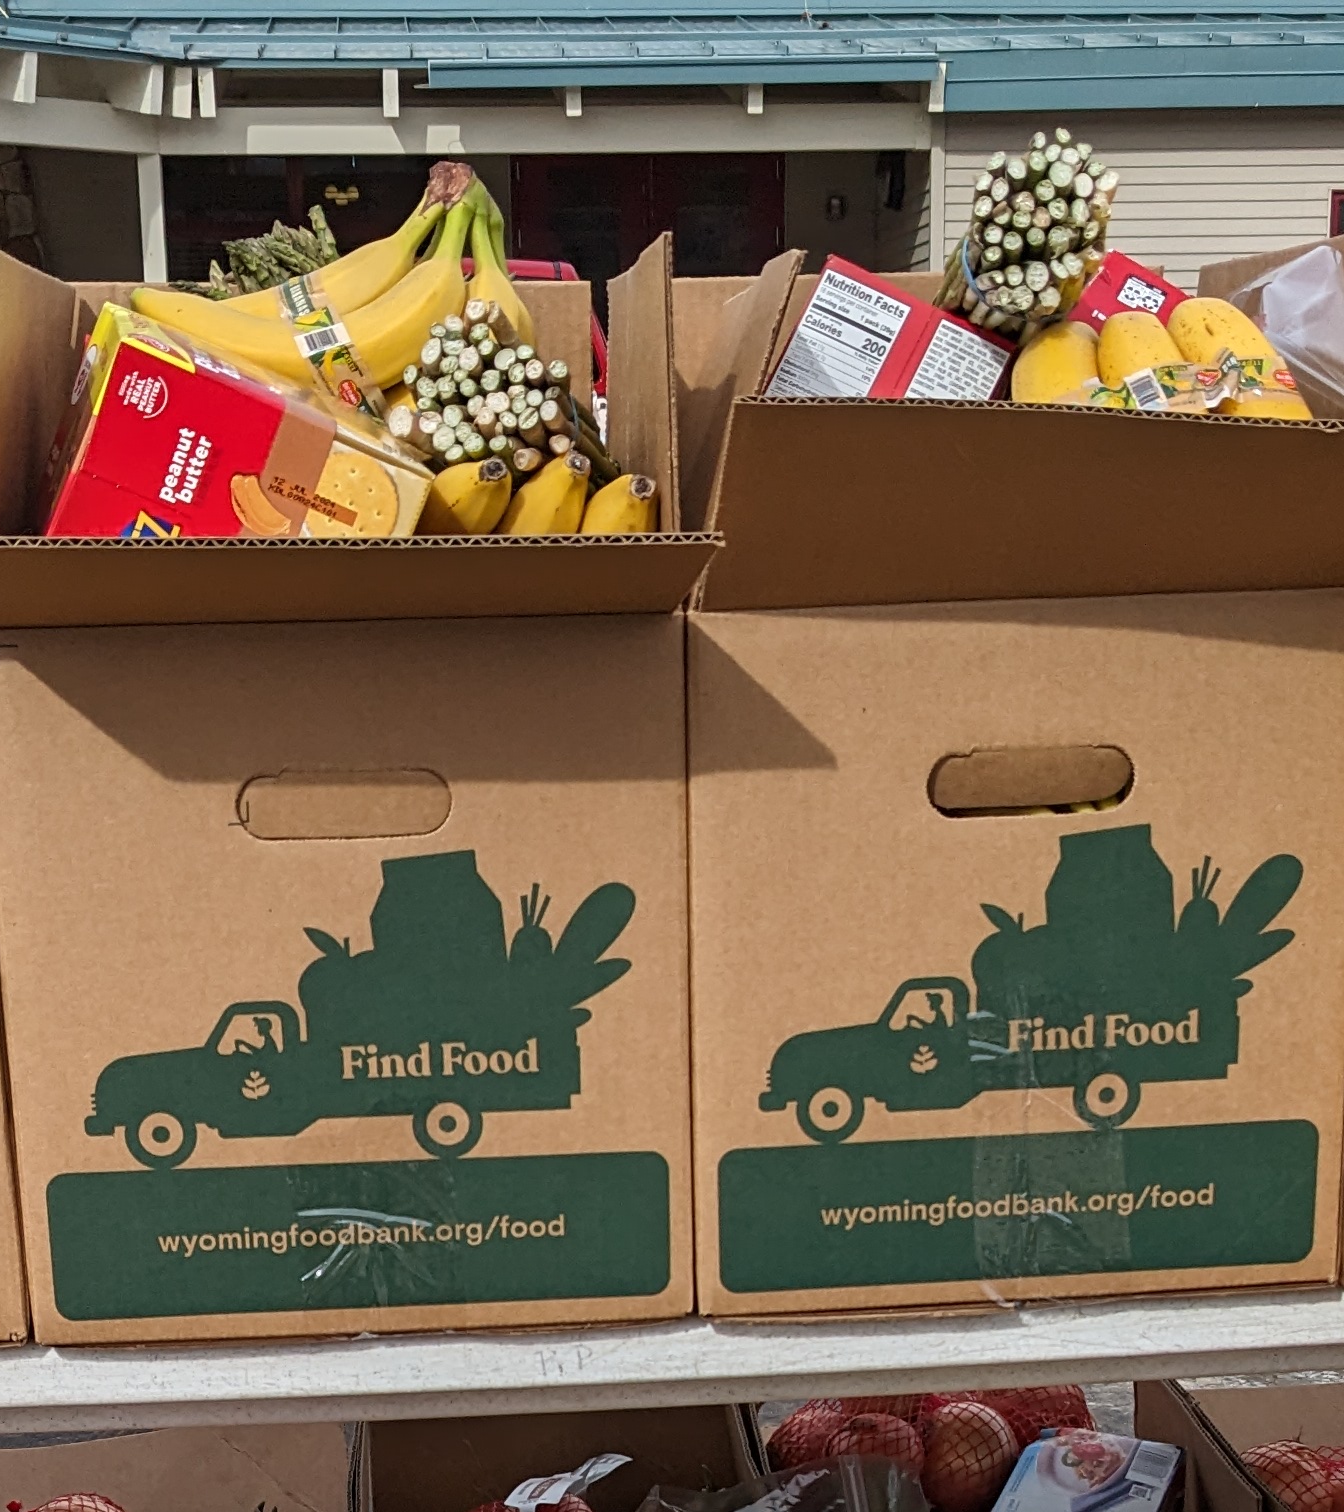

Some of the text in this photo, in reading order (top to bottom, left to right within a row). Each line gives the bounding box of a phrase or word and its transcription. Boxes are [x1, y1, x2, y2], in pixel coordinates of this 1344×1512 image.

[815, 294, 838, 309] Serving
[824, 272, 874, 303] Nutrition
[873, 295, 907, 319] Facts
[804, 313, 844, 338] Calories
[861, 337, 887, 358] 200
[130, 379, 146, 404] REAL
[137, 377, 154, 411] PEANUT
[145, 381, 161, 413] BUTTER
[159, 427, 195, 504] peanut
[175, 436, 212, 503] butter
[1008, 1009, 1199, 1052] Find Food
[341, 1038, 540, 1080] Find Food
[821, 1183, 1214, 1230] wyomingfoodbank.org/food
[158, 1214, 565, 1257] wyomingfoodbank.org/food
